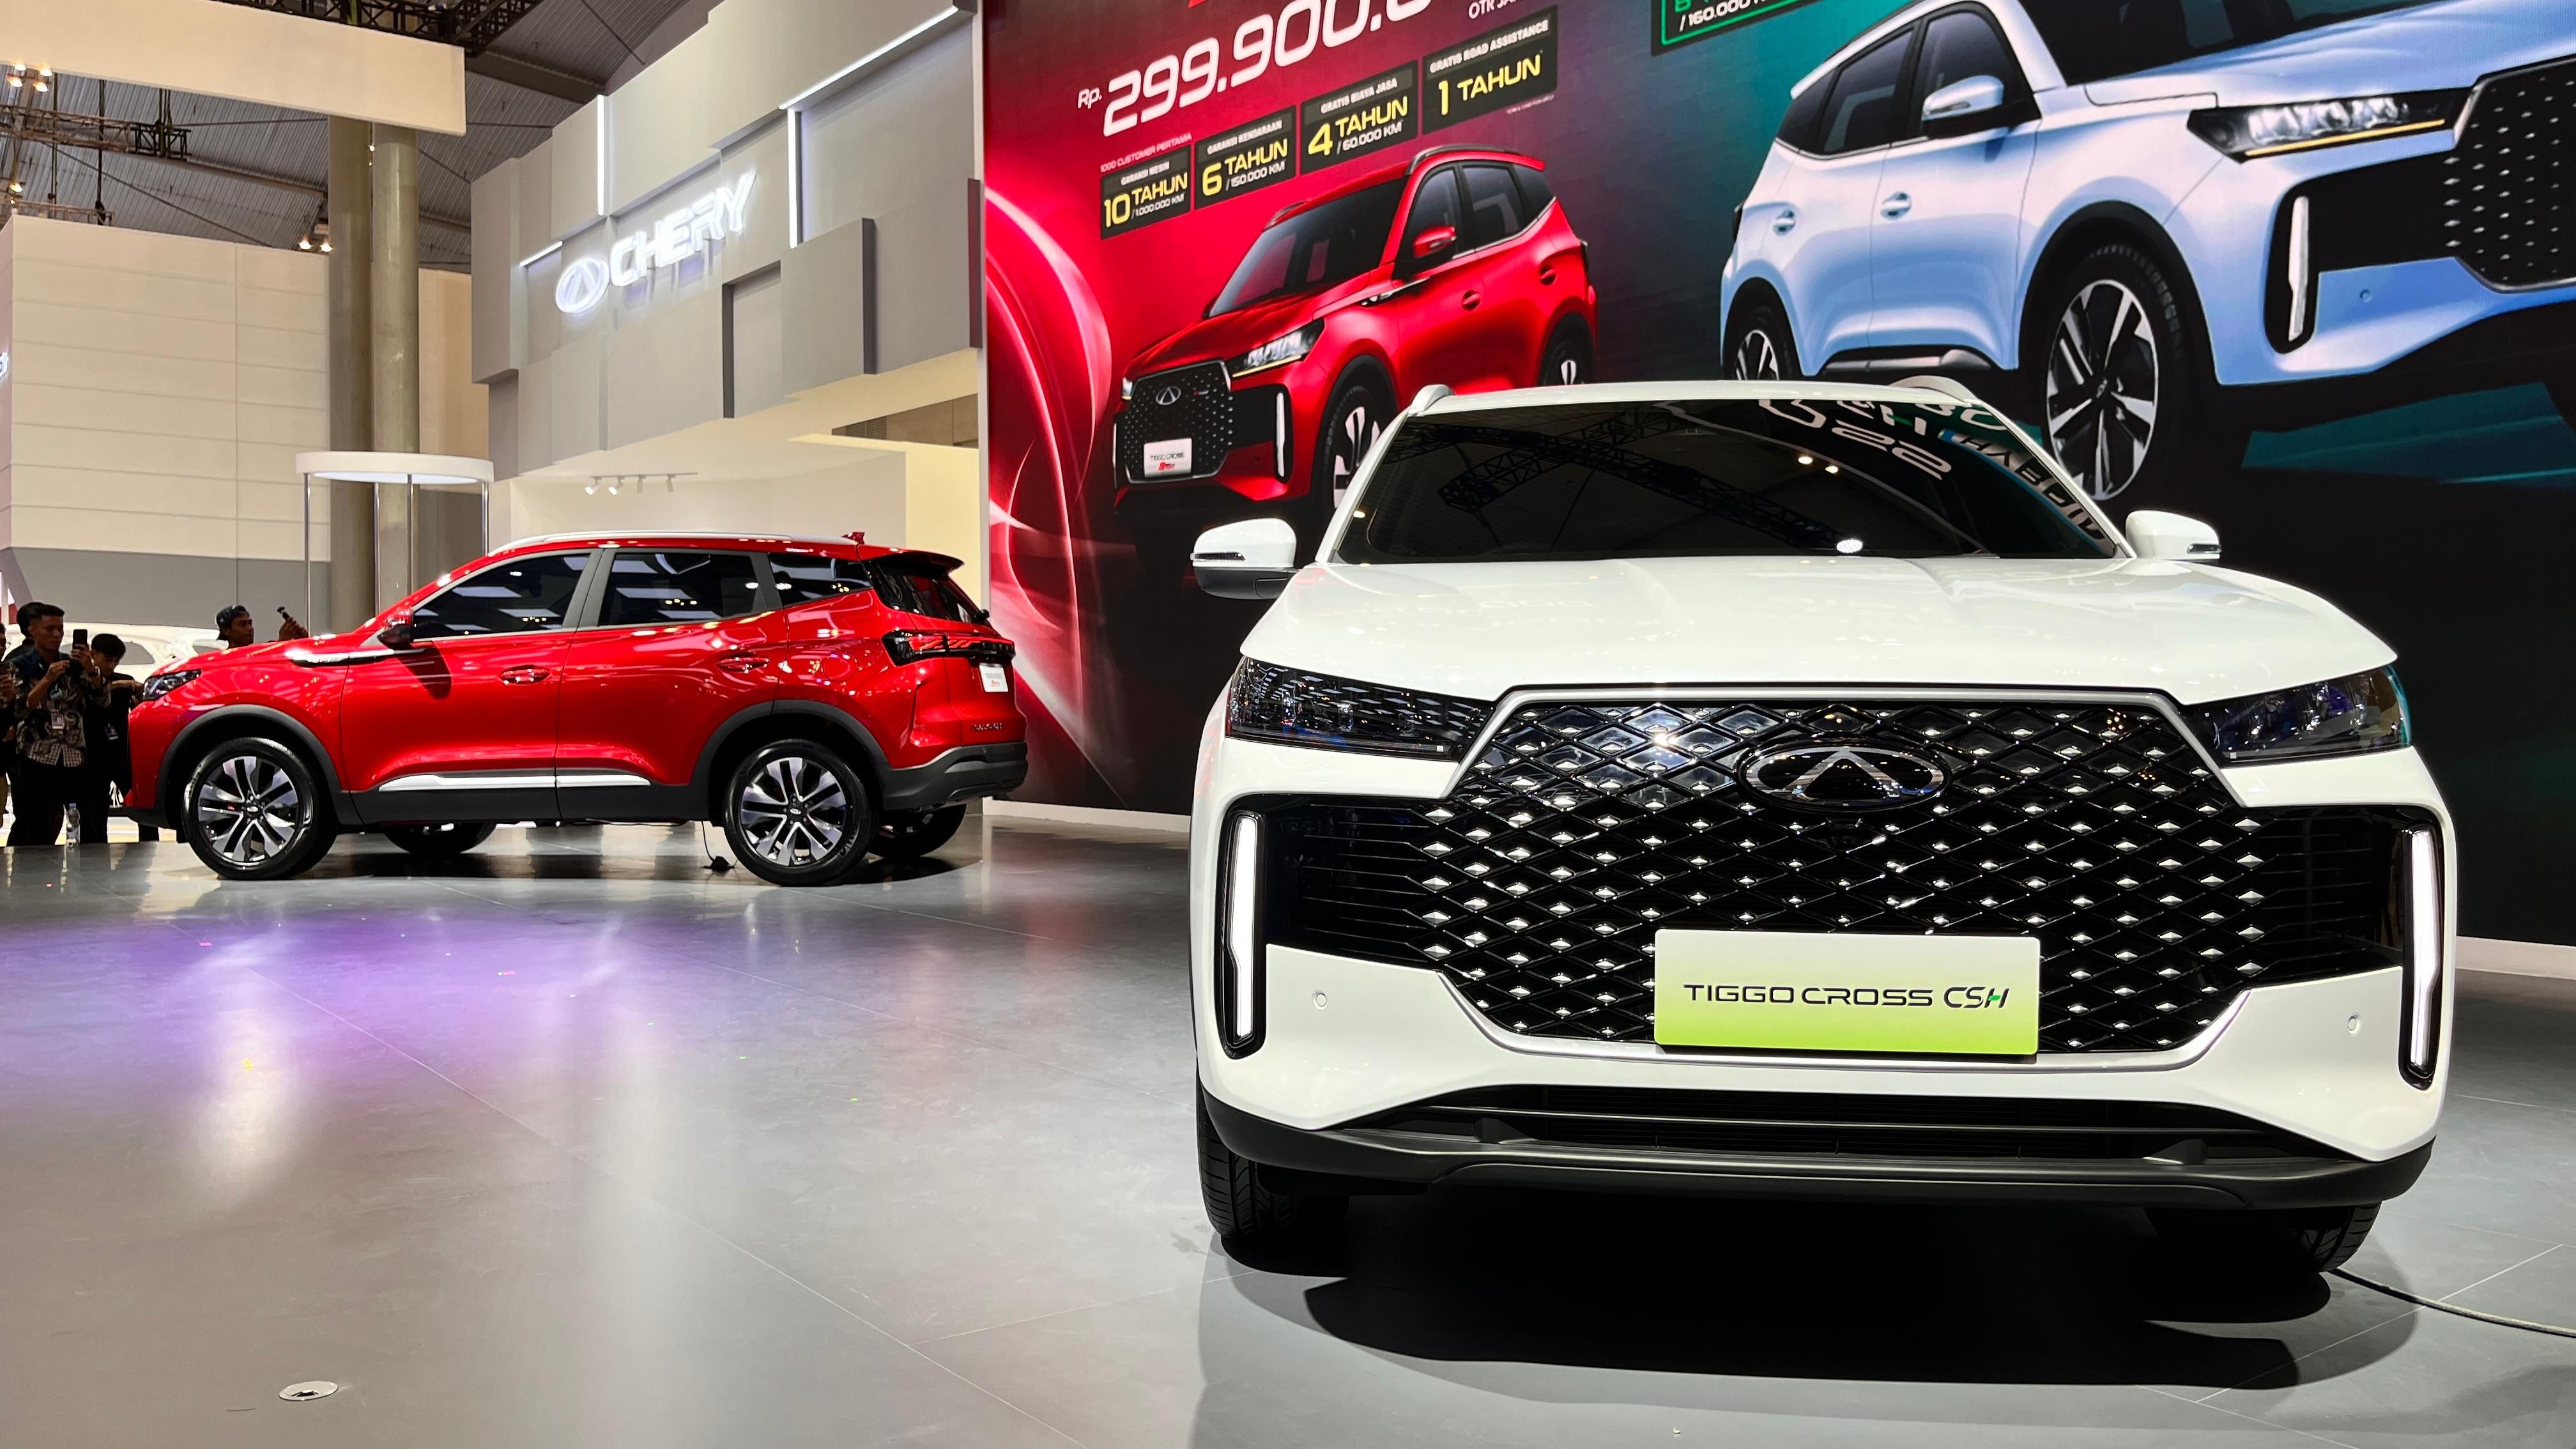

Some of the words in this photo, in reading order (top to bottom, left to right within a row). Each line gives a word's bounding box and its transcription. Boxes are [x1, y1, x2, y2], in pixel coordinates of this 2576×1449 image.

[1430, 53, 1462, 73] GRATIS
[1463, 43, 1489, 61] ROAD
[1490, 19, 1549, 51] ASSISTANCE
[1078, 88, 1102, 109] Rp.
[1321, 95, 1350, 114] GRATIS
[1351, 86, 1375, 103] BIAYA
[1376, 77, 1398, 94] JASA
[1439, 79, 1448, 115] 1
[1457, 54, 1540, 102] TAHUN
[1100, 160, 1117, 172] 1000
[1117, 146, 1156, 167] CUSTOMER
[1156, 132, 1192, 152] PERTAMA
[1206, 136, 1238, 155] GARANSI
[1238, 119, 1283, 144] KENDARAAN
[1307, 122, 1333, 156] 4
[1335, 96, 1408, 137] TAHUN
[1202, 162, 1222, 196] 6
[1224, 138, 1288, 176] TAHUN
[1104, 193, 1131, 227] 10
[1131, 172, 1188, 206] TAHUN
[610, 172, 756, 287] CHERY
[1683, 984, 1795, 1003] TIGGO
[1802, 987, 1934, 1007] CROSS
[1943, 986, 2011, 1009] CSH
